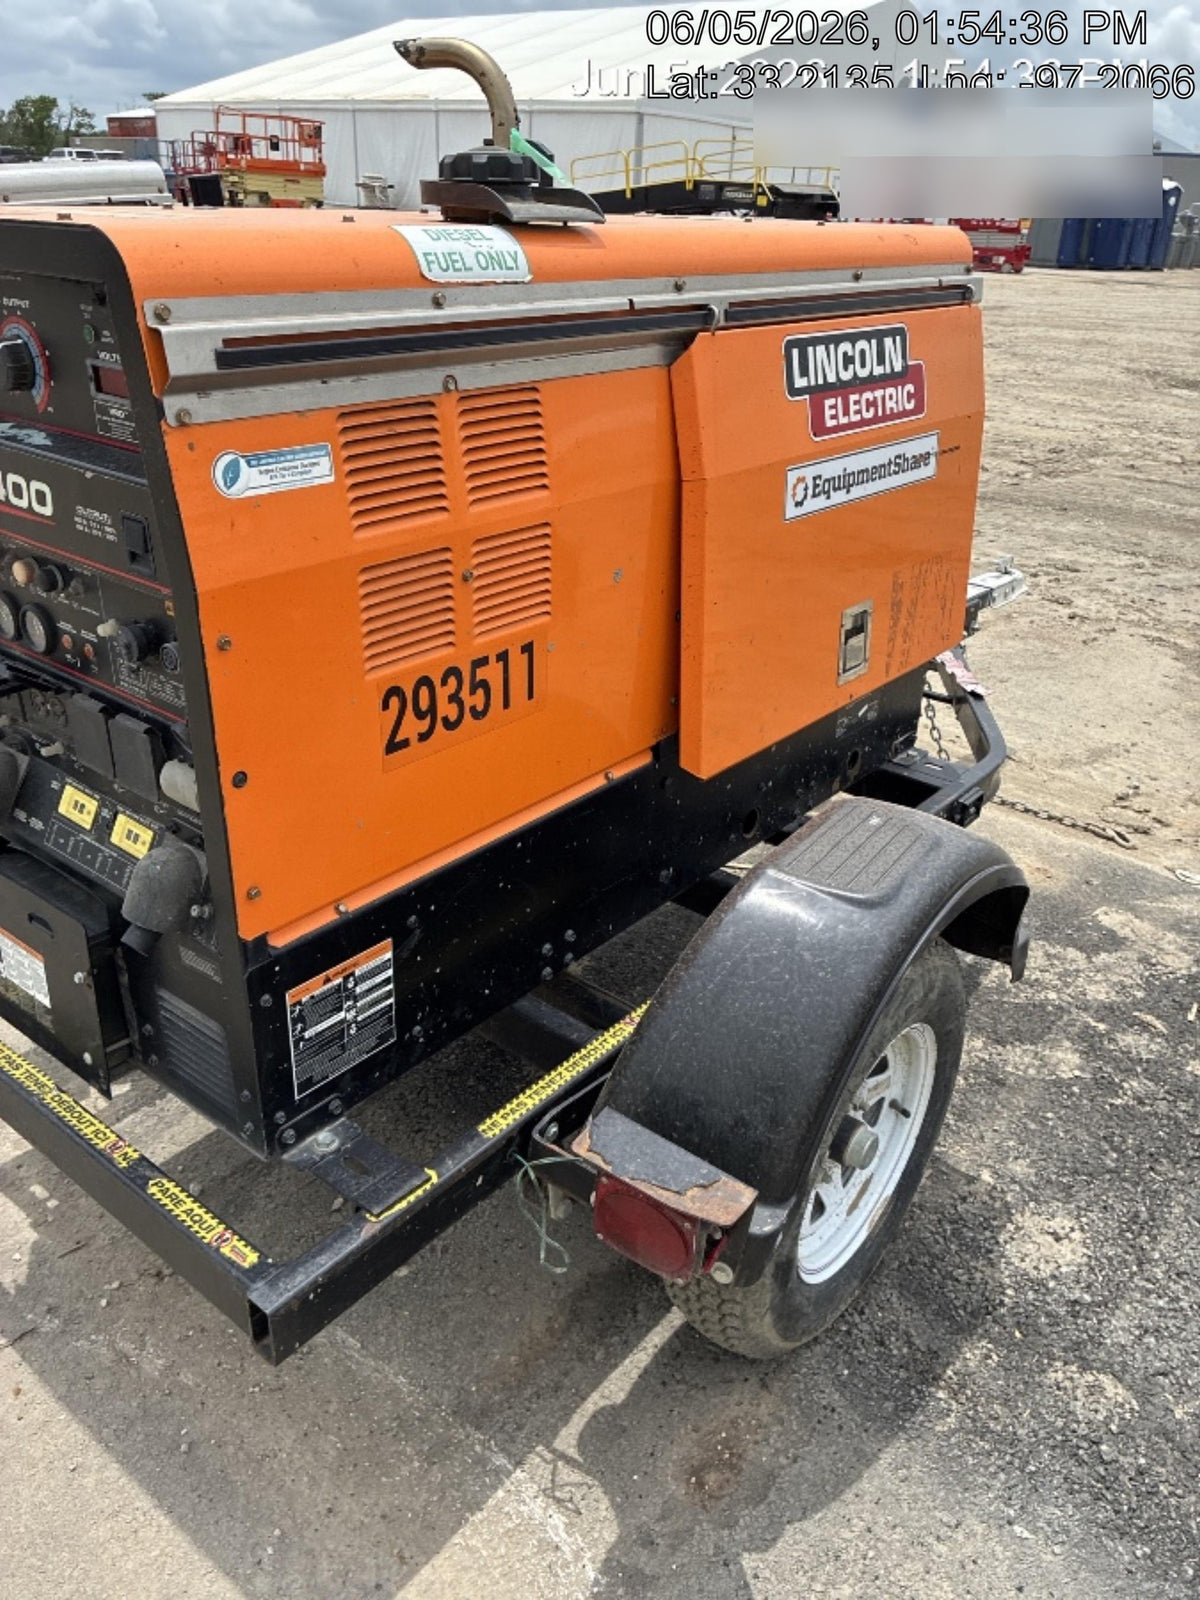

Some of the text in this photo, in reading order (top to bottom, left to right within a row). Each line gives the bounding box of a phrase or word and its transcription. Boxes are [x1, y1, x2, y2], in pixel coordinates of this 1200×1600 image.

[422, 228, 494, 241] DIESEL
[422, 250, 520, 272] FUEL ONLY
[792, 336, 902, 388] LINCOLN
[824, 384, 915, 427] ELECTRIC
[0, 470, 53, 516] 00
[811, 449, 931, 500] EquipmentShare
[382, 640, 534, 756] 293511
[1, 1053, 24, 1071] PAS
[501, 1101, 527, 1120] PAS
[151, 1179, 217, 1235] PARE AQUI
